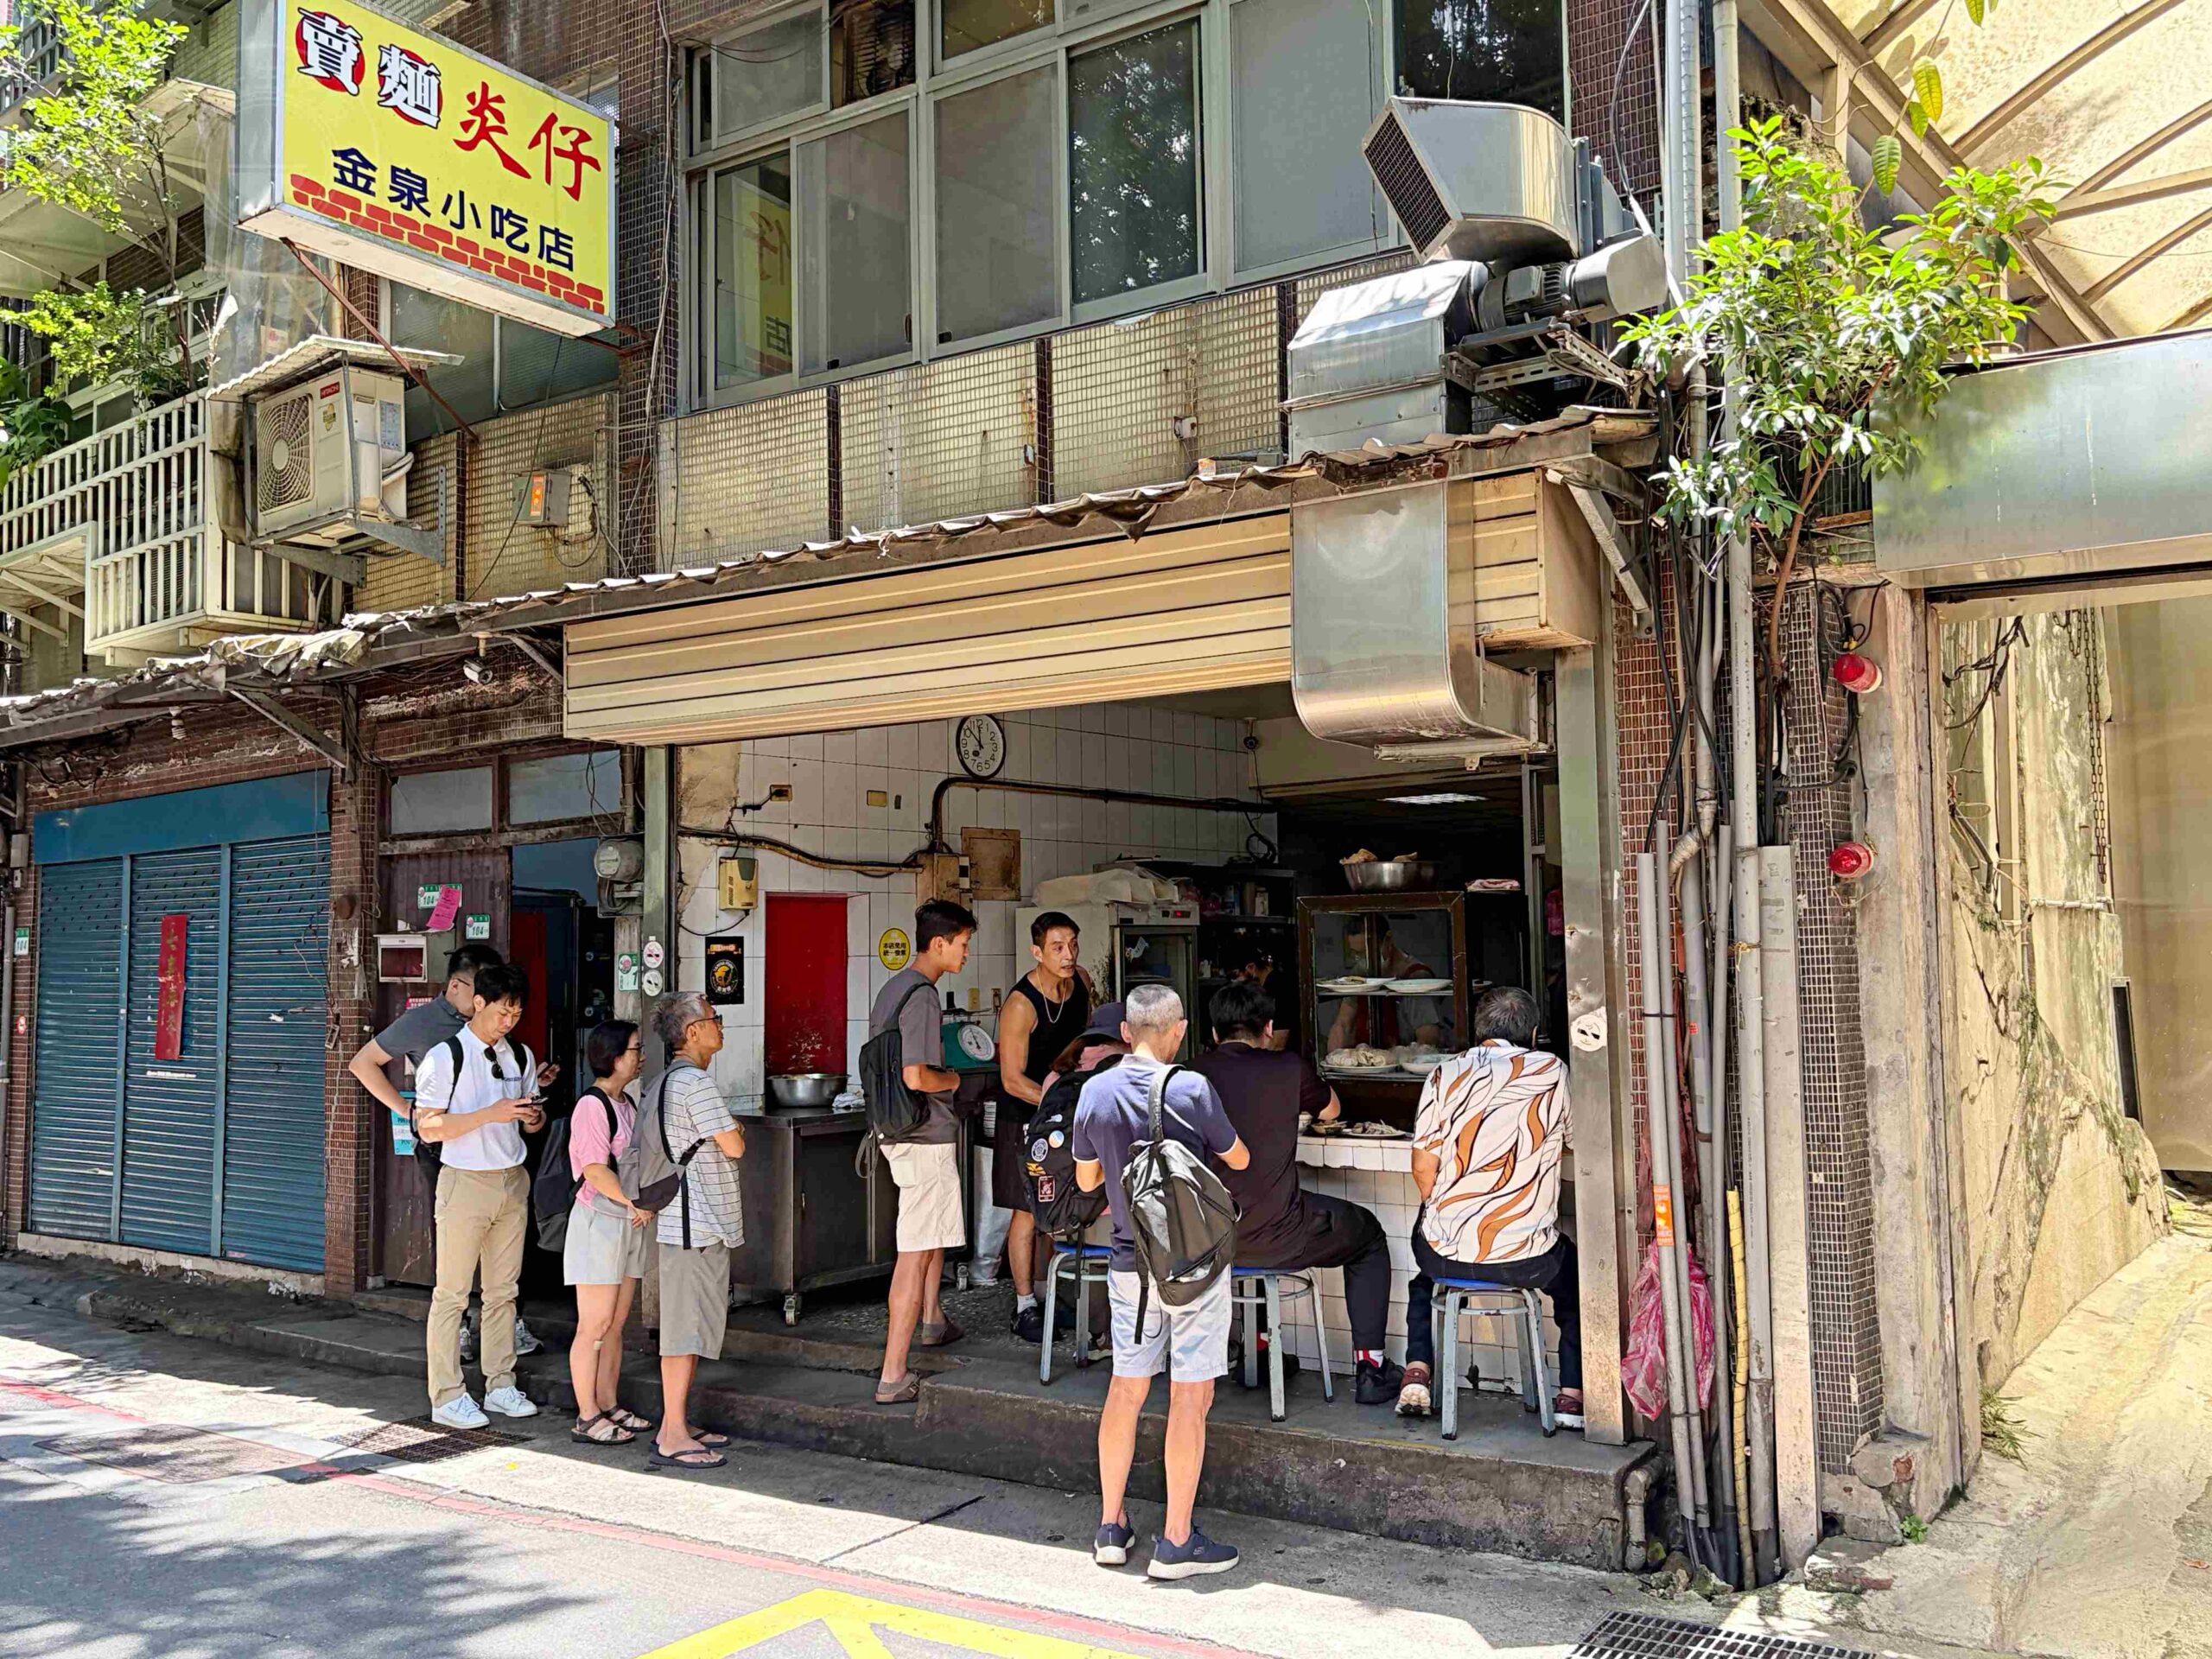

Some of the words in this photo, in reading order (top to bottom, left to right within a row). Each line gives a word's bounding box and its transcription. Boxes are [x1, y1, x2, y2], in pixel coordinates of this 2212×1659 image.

[298, 7, 601, 201] 賣麵炎仔
[332, 148, 575, 271] 金泉小吃店
[321, 384, 340, 397] HITACHI
[969, 720, 976, 730] 11
[989, 732, 995, 741] 2
[962, 738, 968, 748] 9
[992, 742, 998, 753] 3
[963, 749, 969, 760] 8
[971, 759, 976, 767] 7
[976, 762, 983, 772] 6
[984, 760, 990, 770] 5
[423, 895, 435, 906] 104
[472, 926, 484, 936] 104
